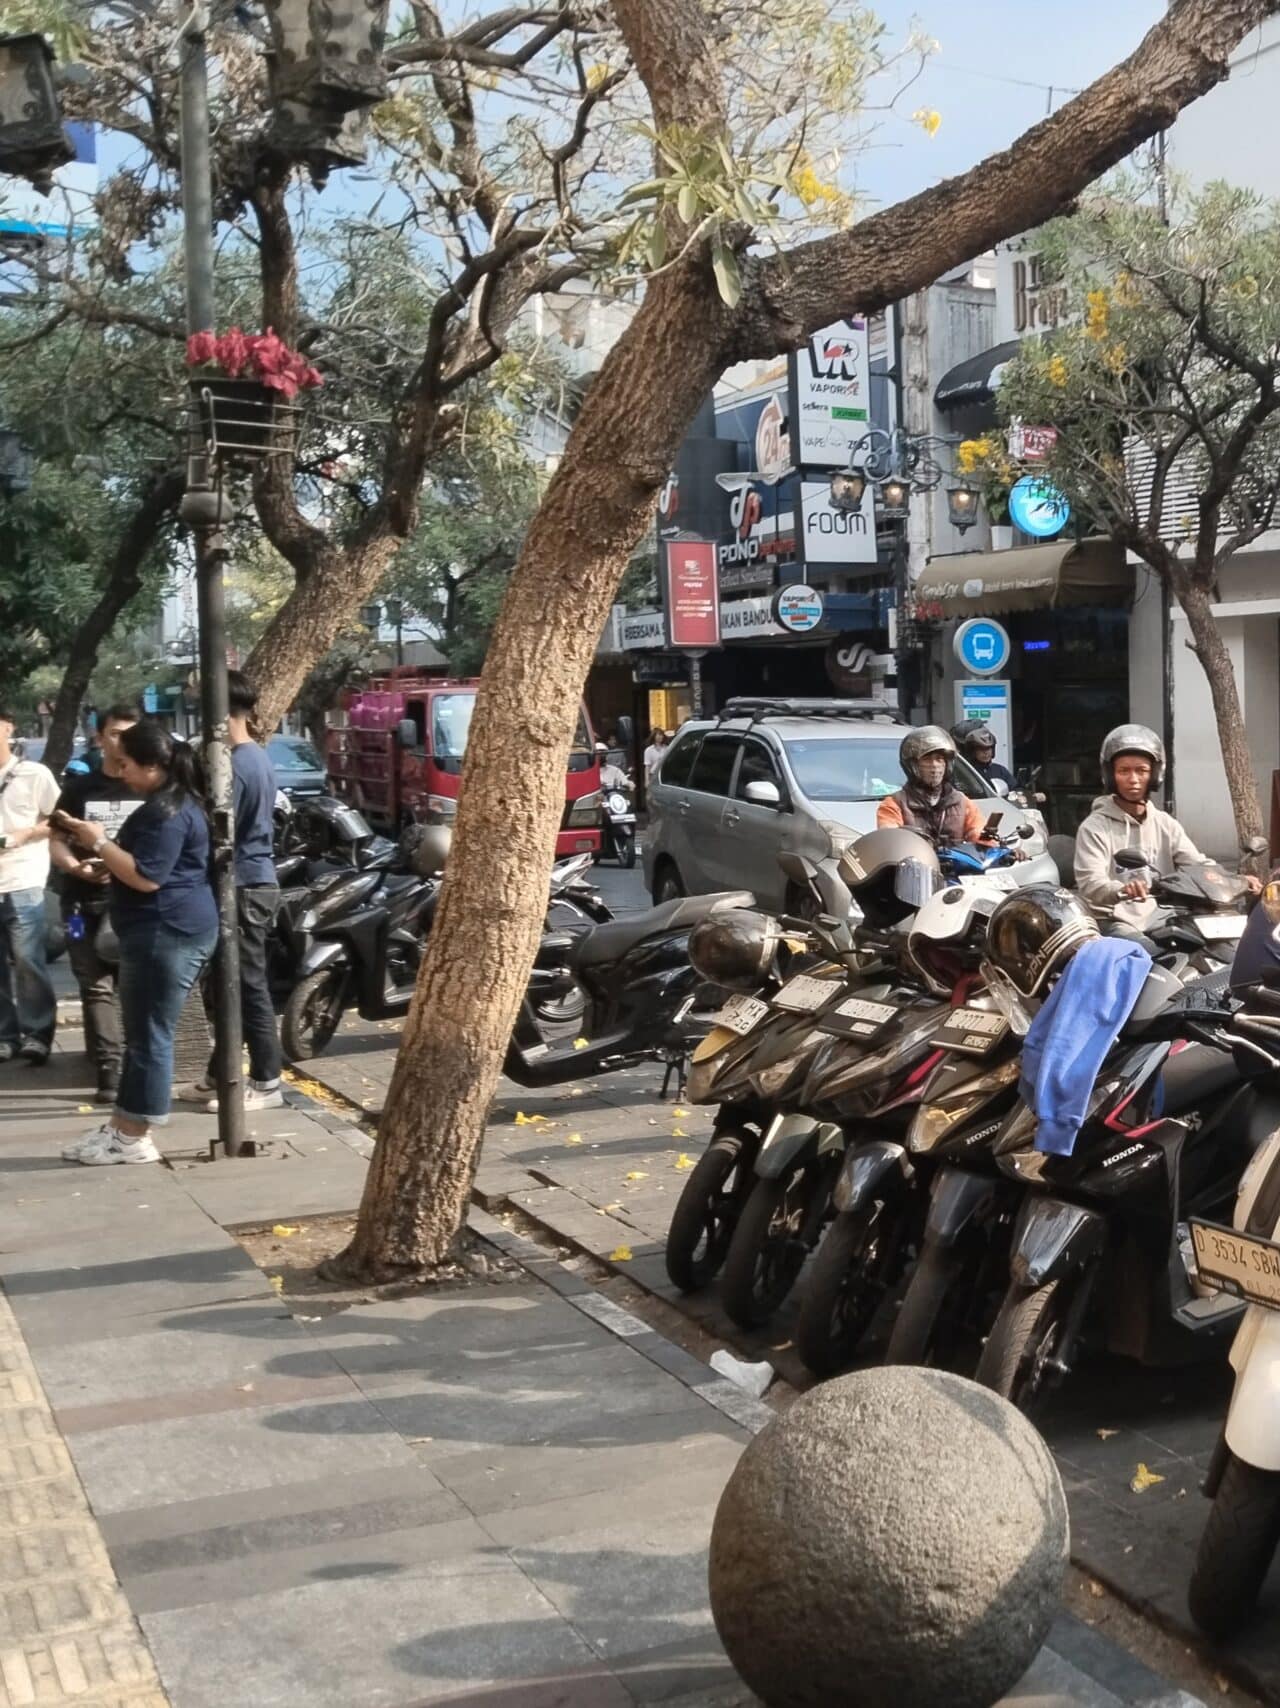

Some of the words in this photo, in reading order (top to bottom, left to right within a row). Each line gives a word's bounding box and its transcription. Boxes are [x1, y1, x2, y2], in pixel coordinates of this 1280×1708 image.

[743, 609, 774, 627] BANDU
[1102, 1143, 1145, 1168] HONDA
[1196, 1230, 1205, 1252] D
[1211, 1236, 1247, 1267] 3534
[1251, 1249, 1280, 1277] SBW
